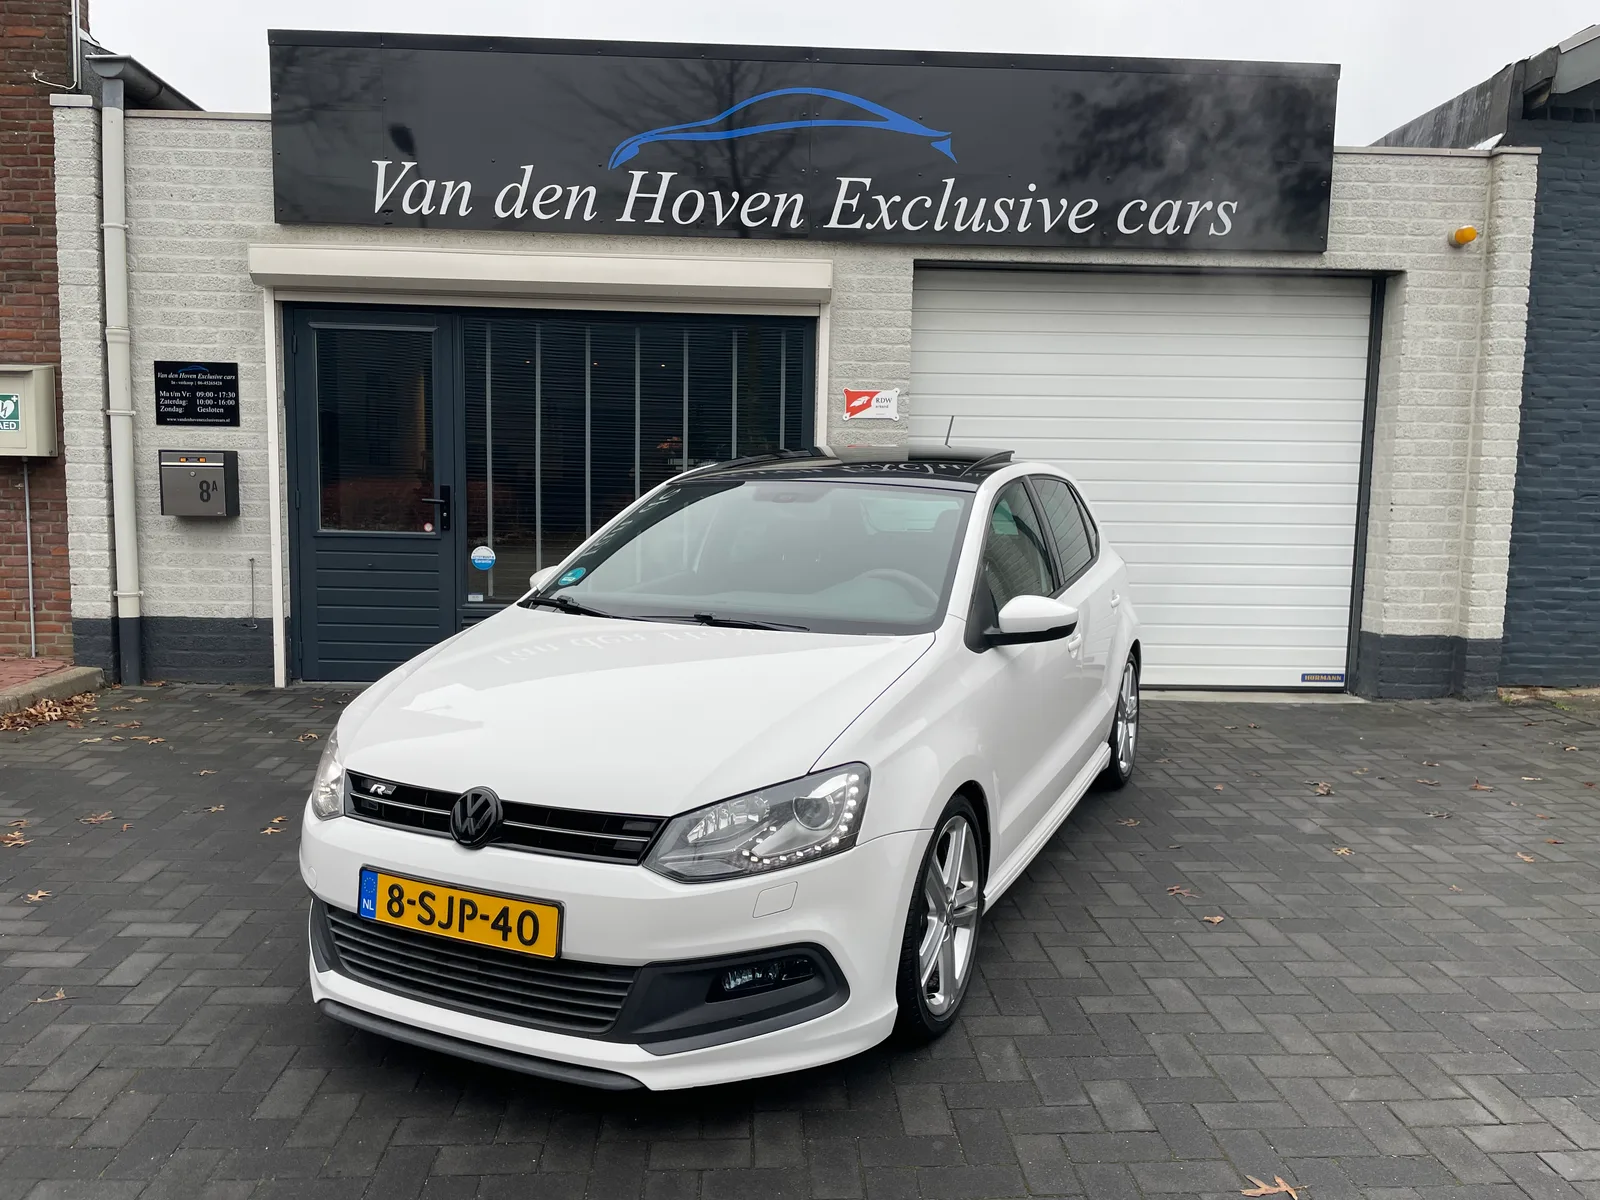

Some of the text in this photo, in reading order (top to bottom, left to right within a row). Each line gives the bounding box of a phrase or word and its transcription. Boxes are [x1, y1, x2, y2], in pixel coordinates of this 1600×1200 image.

[372, 160, 1239, 236] Van den Hoven Exclusive cars
[362, 898, 374, 911] NL
[386, 883, 540, 947] 8-SJP-40
